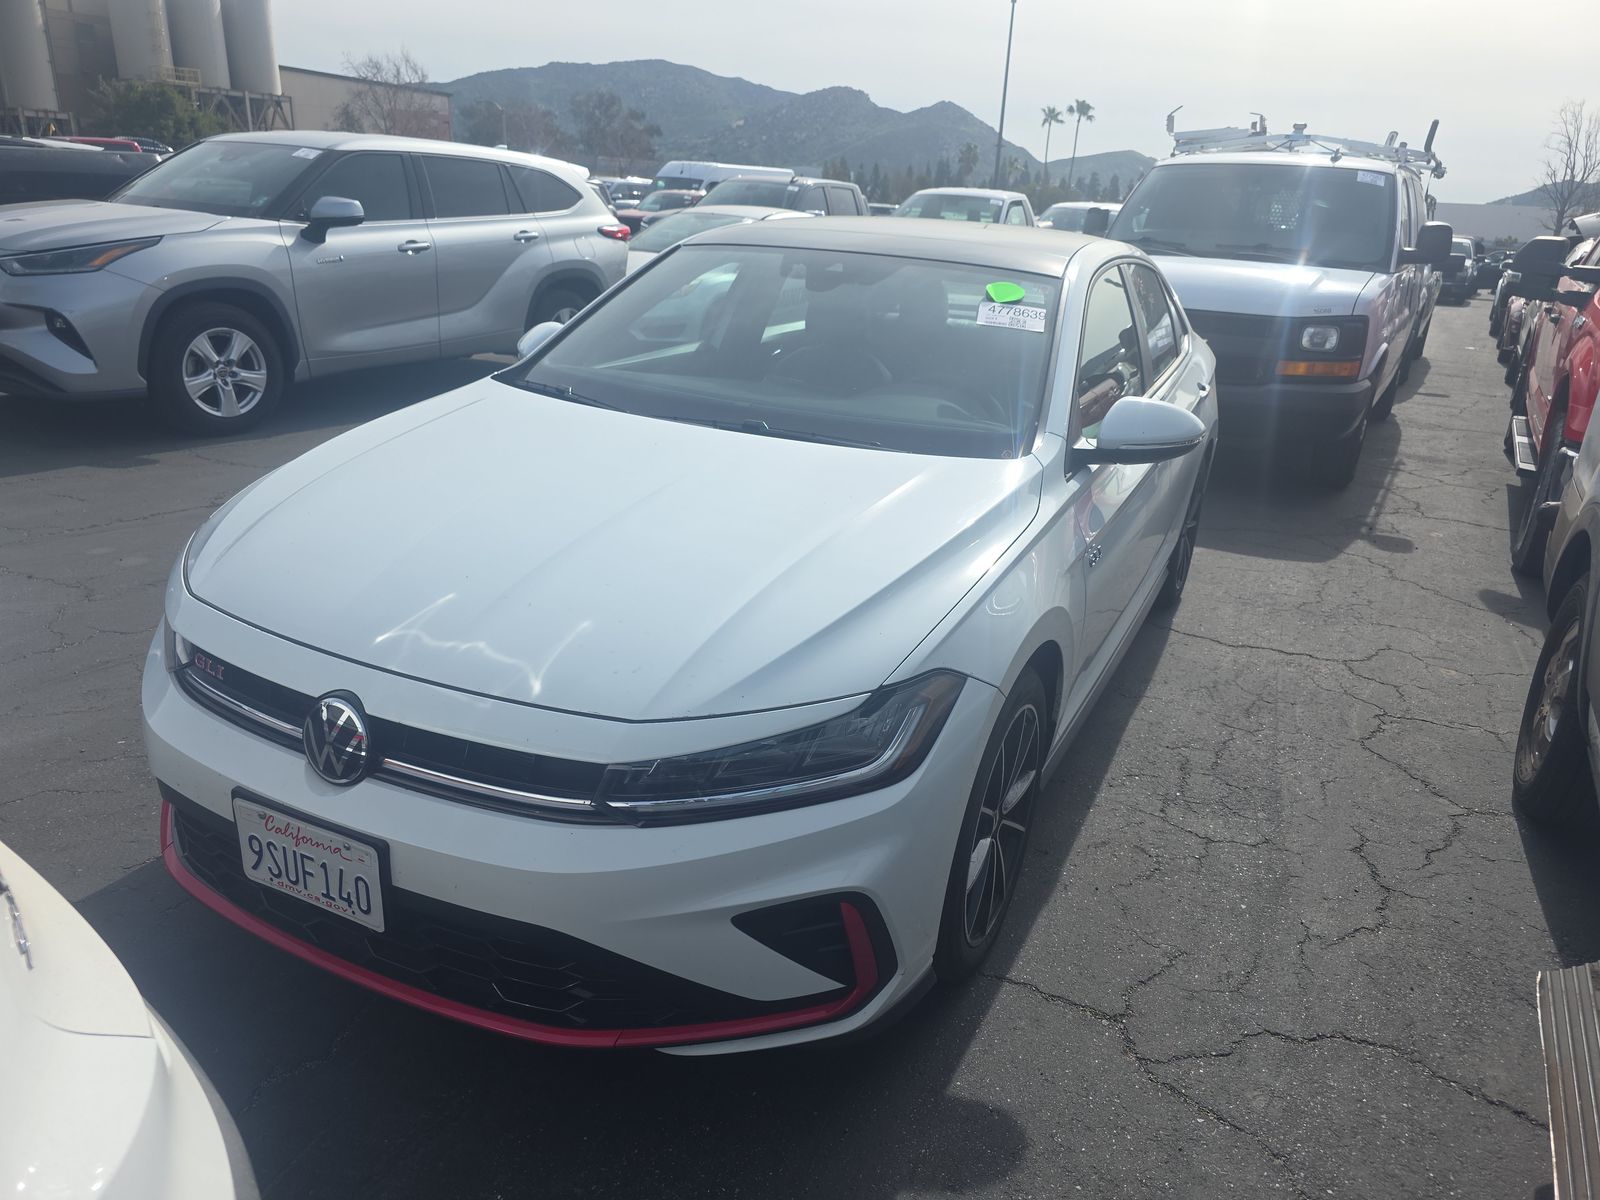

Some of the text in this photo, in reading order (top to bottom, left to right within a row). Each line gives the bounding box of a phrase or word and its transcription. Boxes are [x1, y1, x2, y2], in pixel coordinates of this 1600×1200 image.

[988, 304, 1046, 321] 4778639
[195, 652, 225, 681] GLI
[264, 814, 353, 862] California
[248, 834, 372, 915] 9SUF140
[277, 879, 349, 914] dmv.ca.gov
